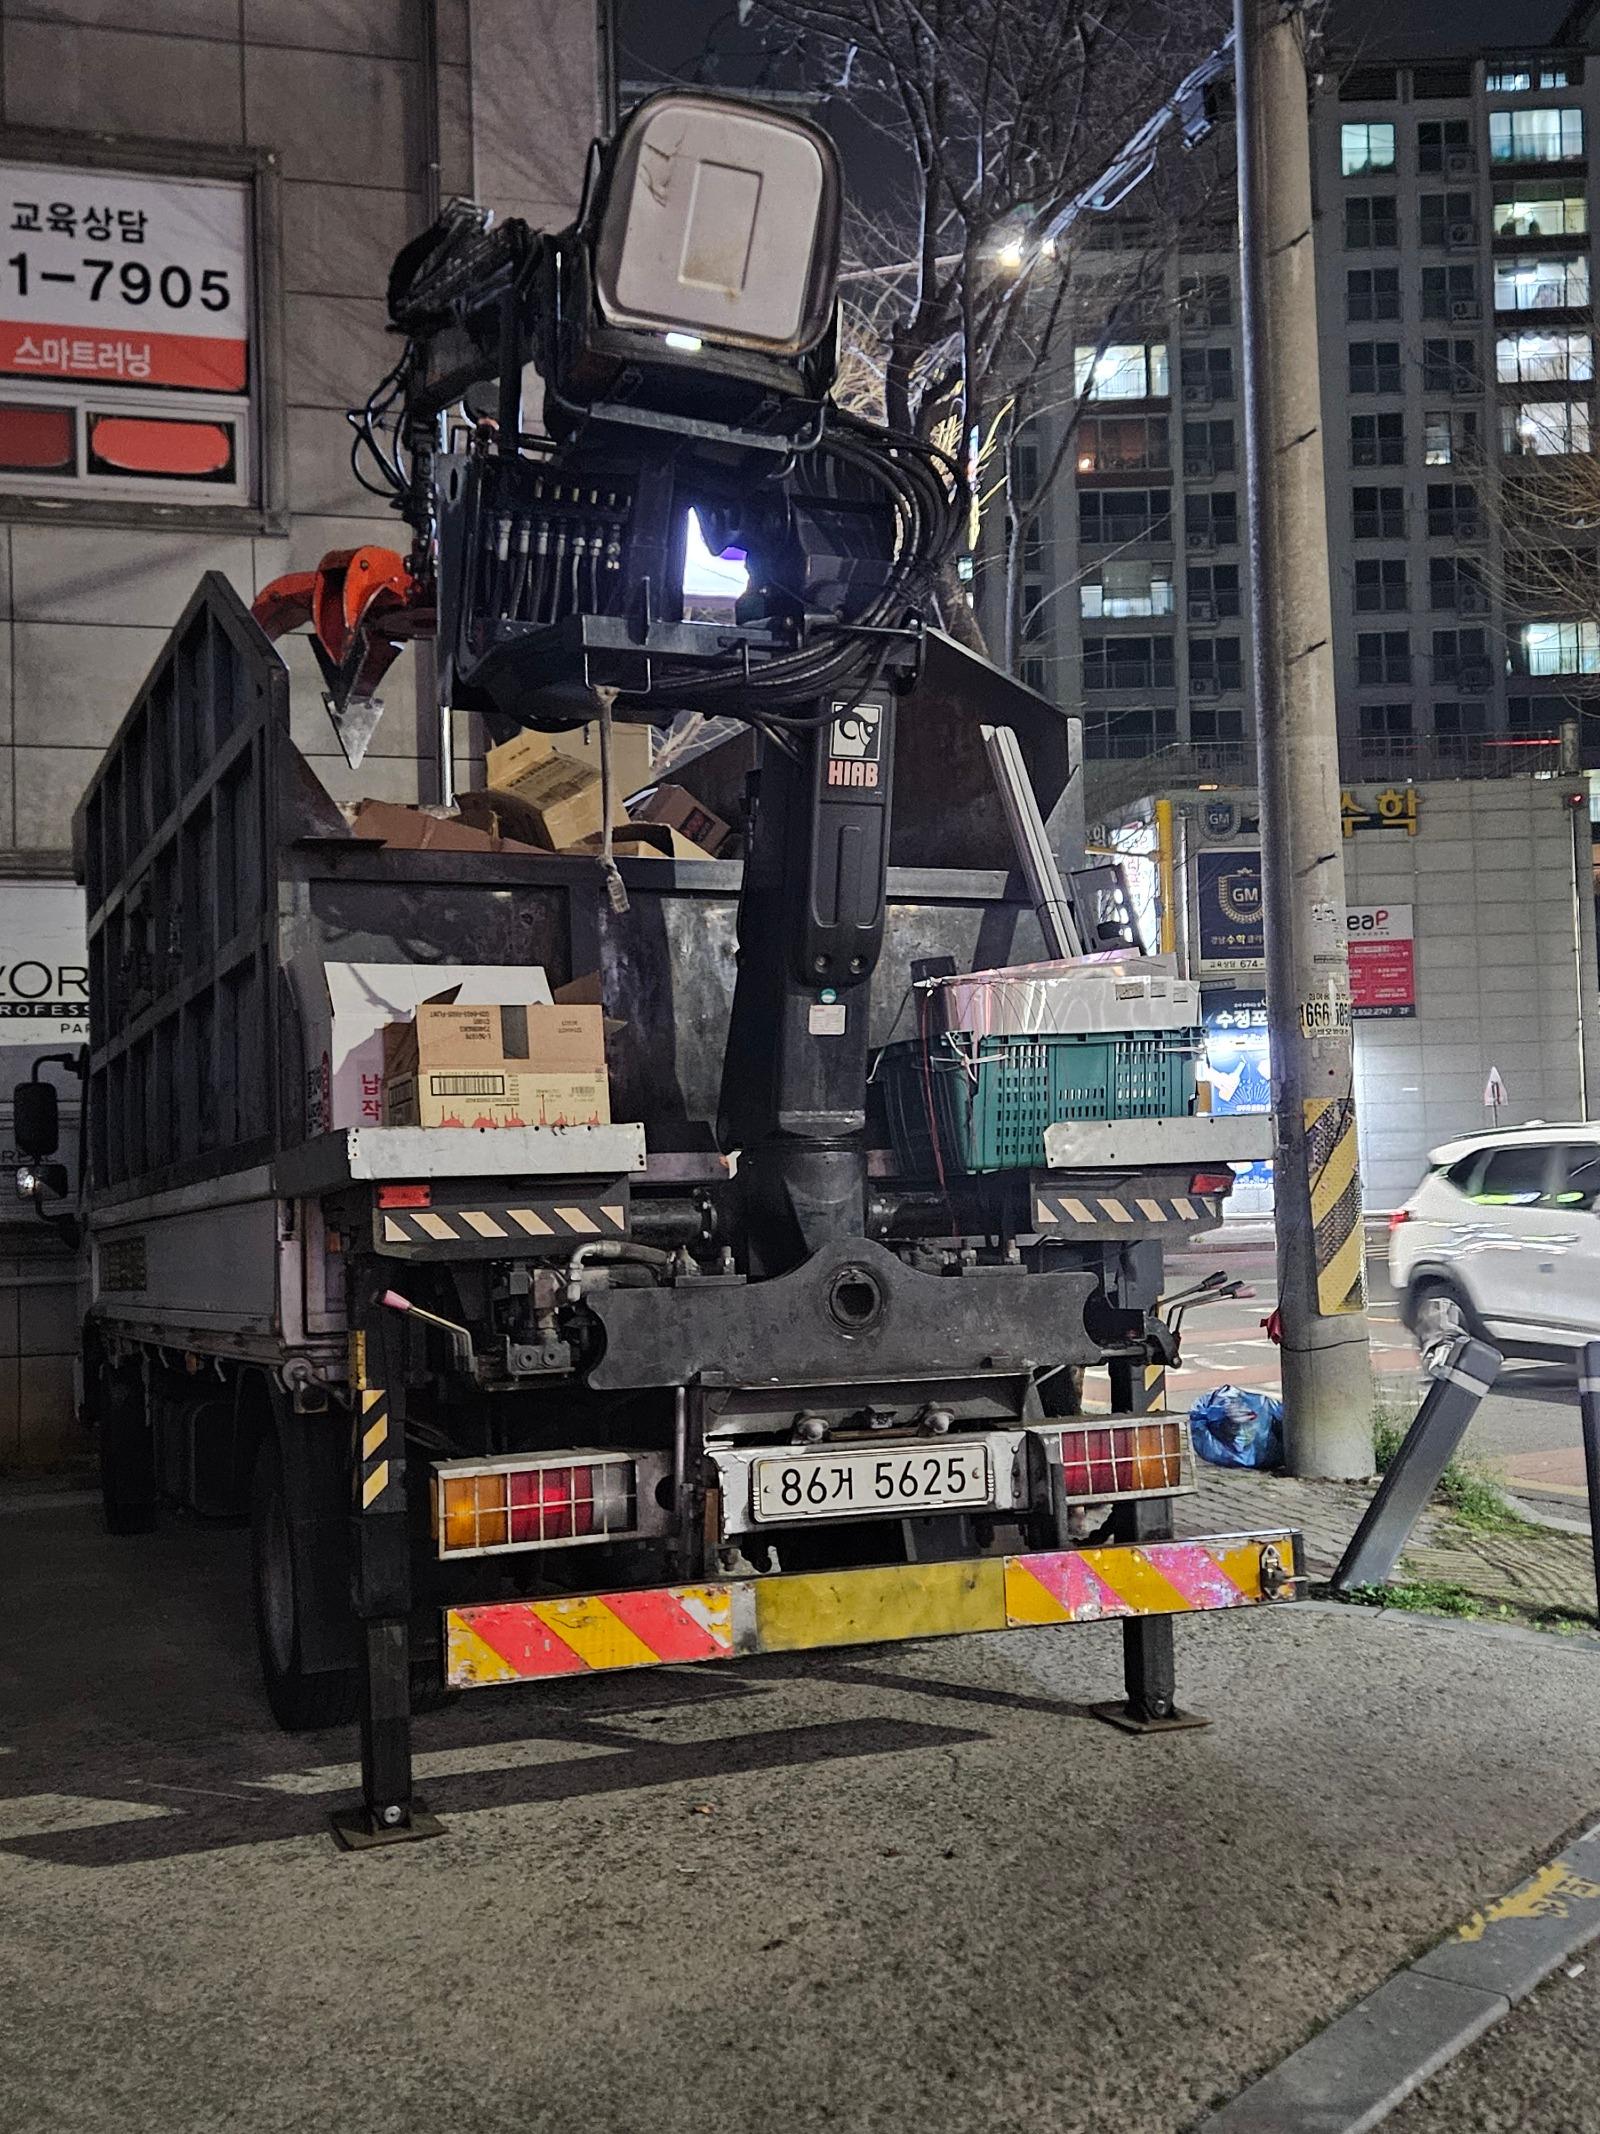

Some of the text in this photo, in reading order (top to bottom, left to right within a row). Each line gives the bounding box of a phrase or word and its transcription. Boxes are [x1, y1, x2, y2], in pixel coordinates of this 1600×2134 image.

[10, 202, 149, 244] 교육상담
[9, 252, 231, 312] 1-7905
[13, 336, 151, 378] 스마트러닝
[828, 761, 878, 787] HIAB
[1209, 812, 1230, 825] GM
[1232, 888, 1259, 903] GM
[782, 1457, 966, 1506] 86거 5625
